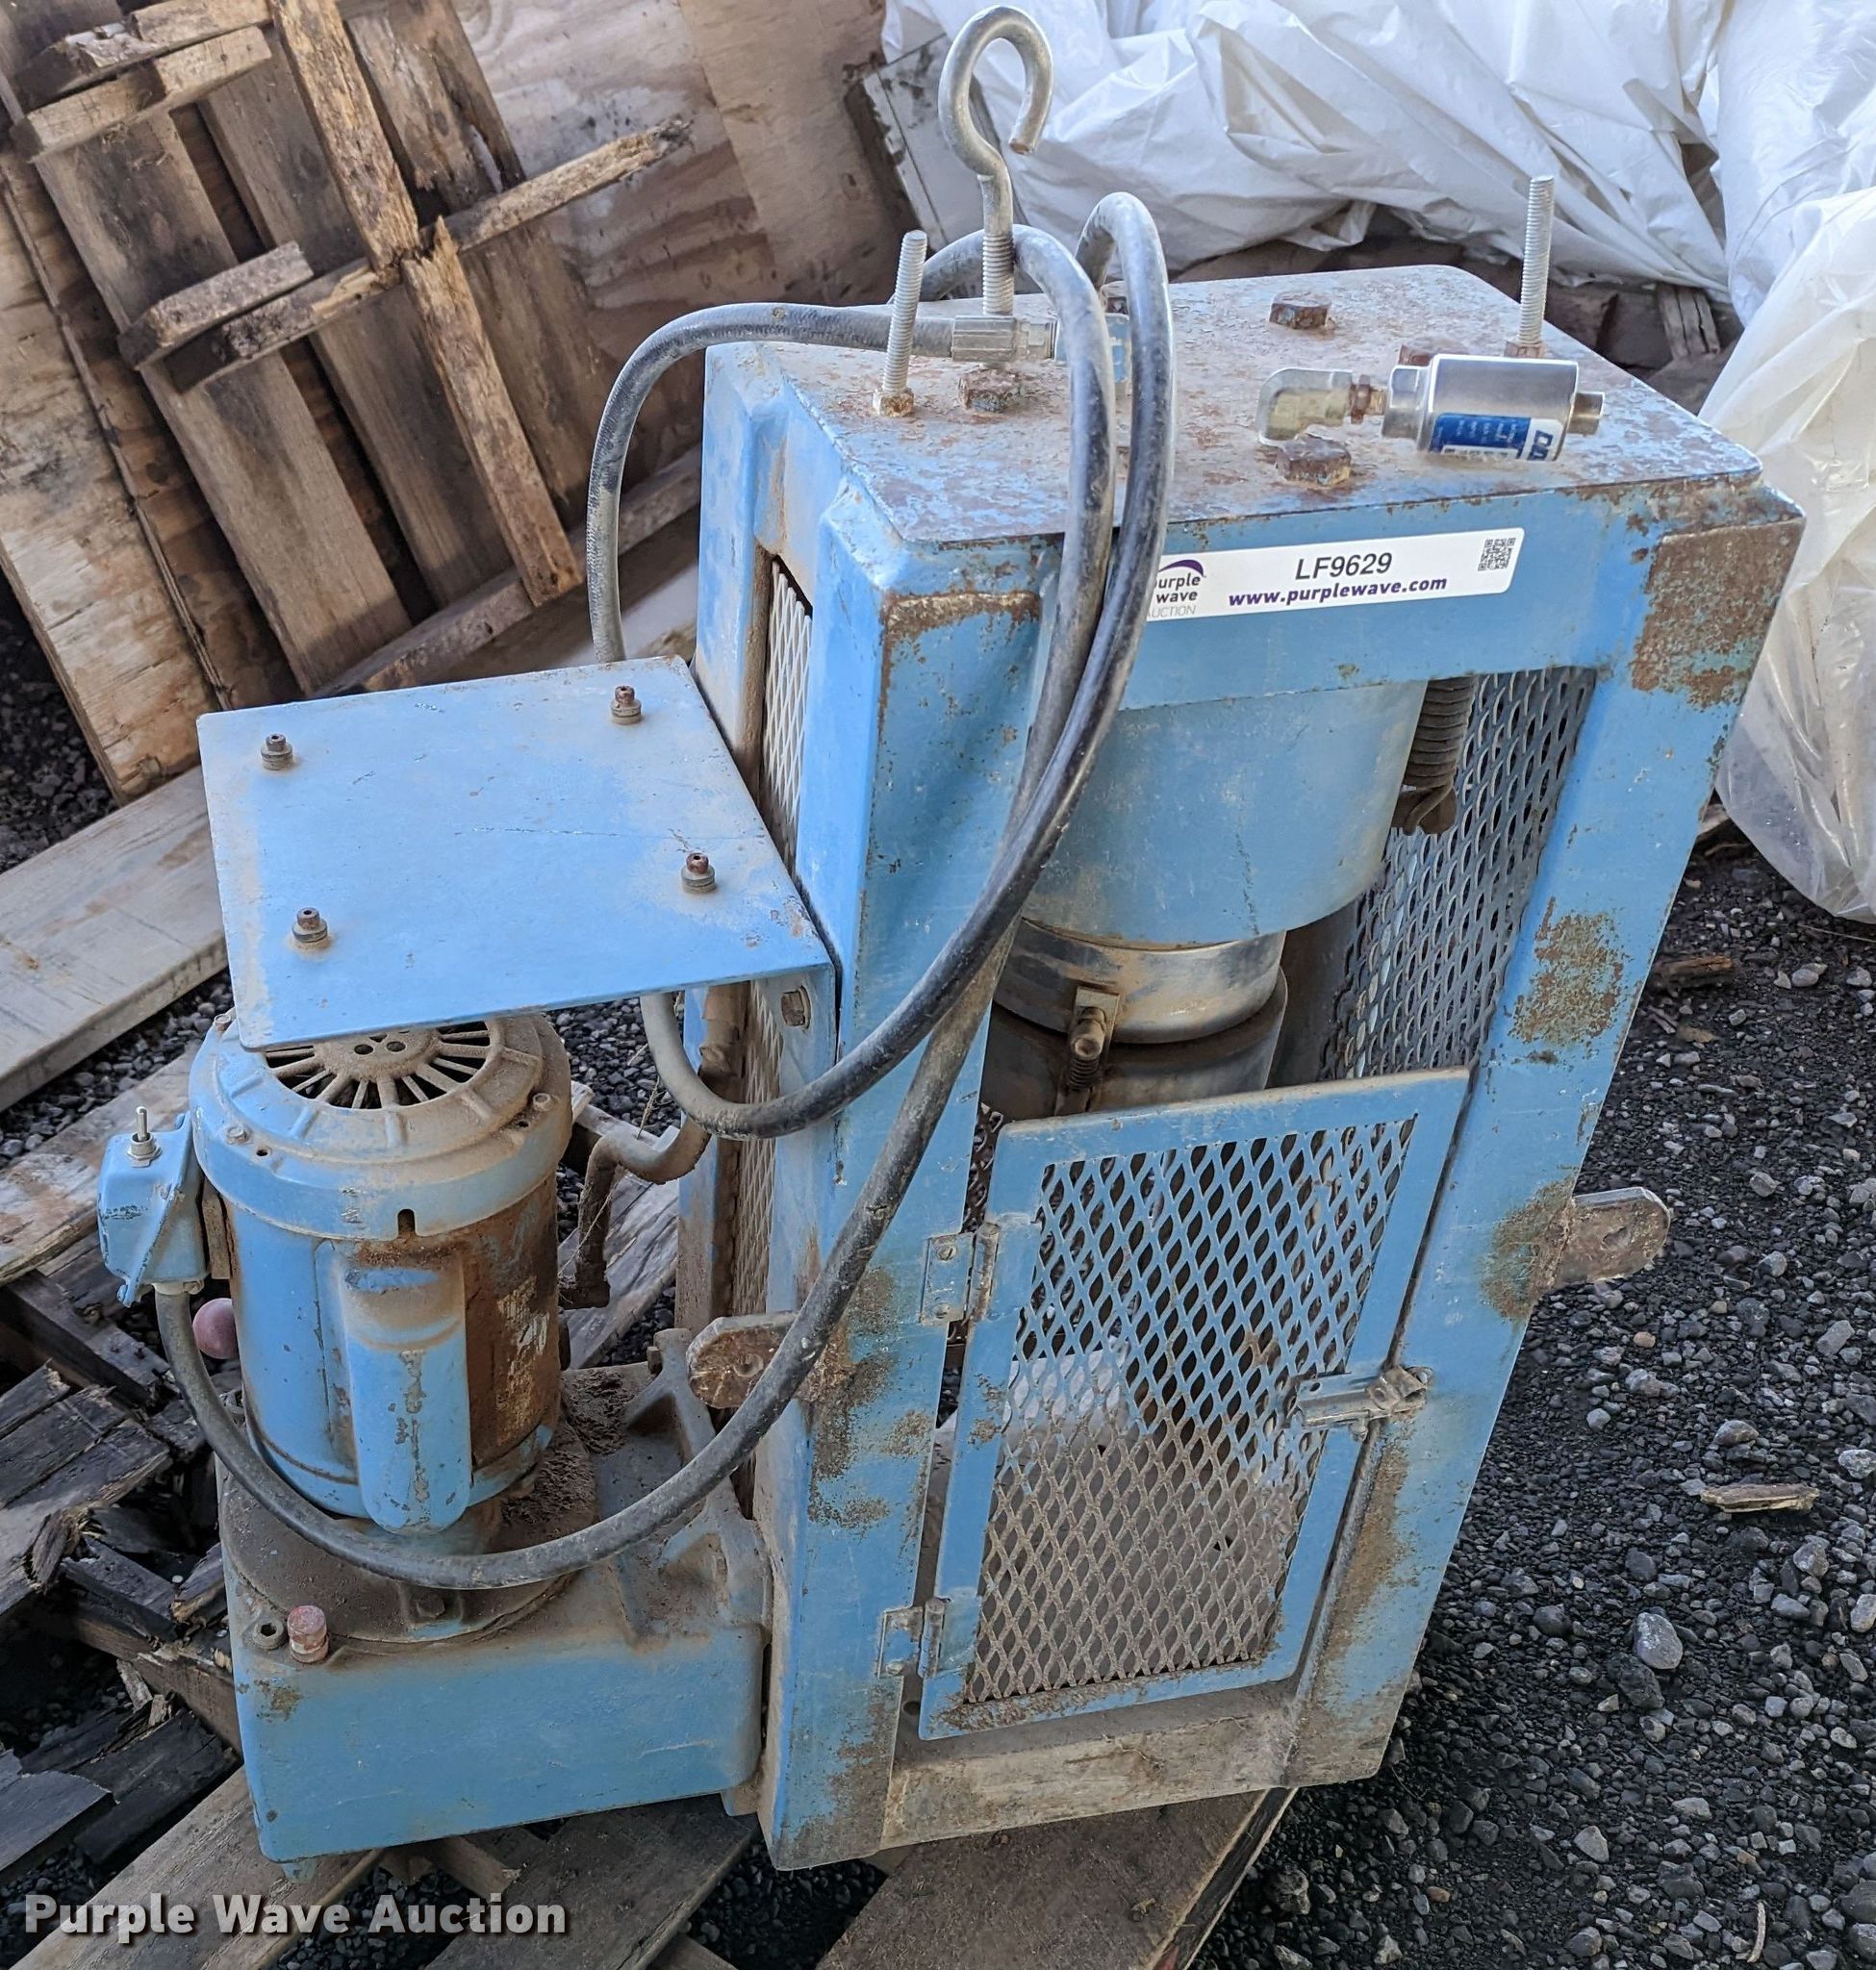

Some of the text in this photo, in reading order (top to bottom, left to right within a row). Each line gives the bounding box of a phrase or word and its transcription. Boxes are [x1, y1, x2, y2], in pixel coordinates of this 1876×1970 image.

[1295, 552, 1393, 581] LF9629
[1156, 592, 1198, 604] wave
[1229, 577, 1447, 607] www.purplewave.com
